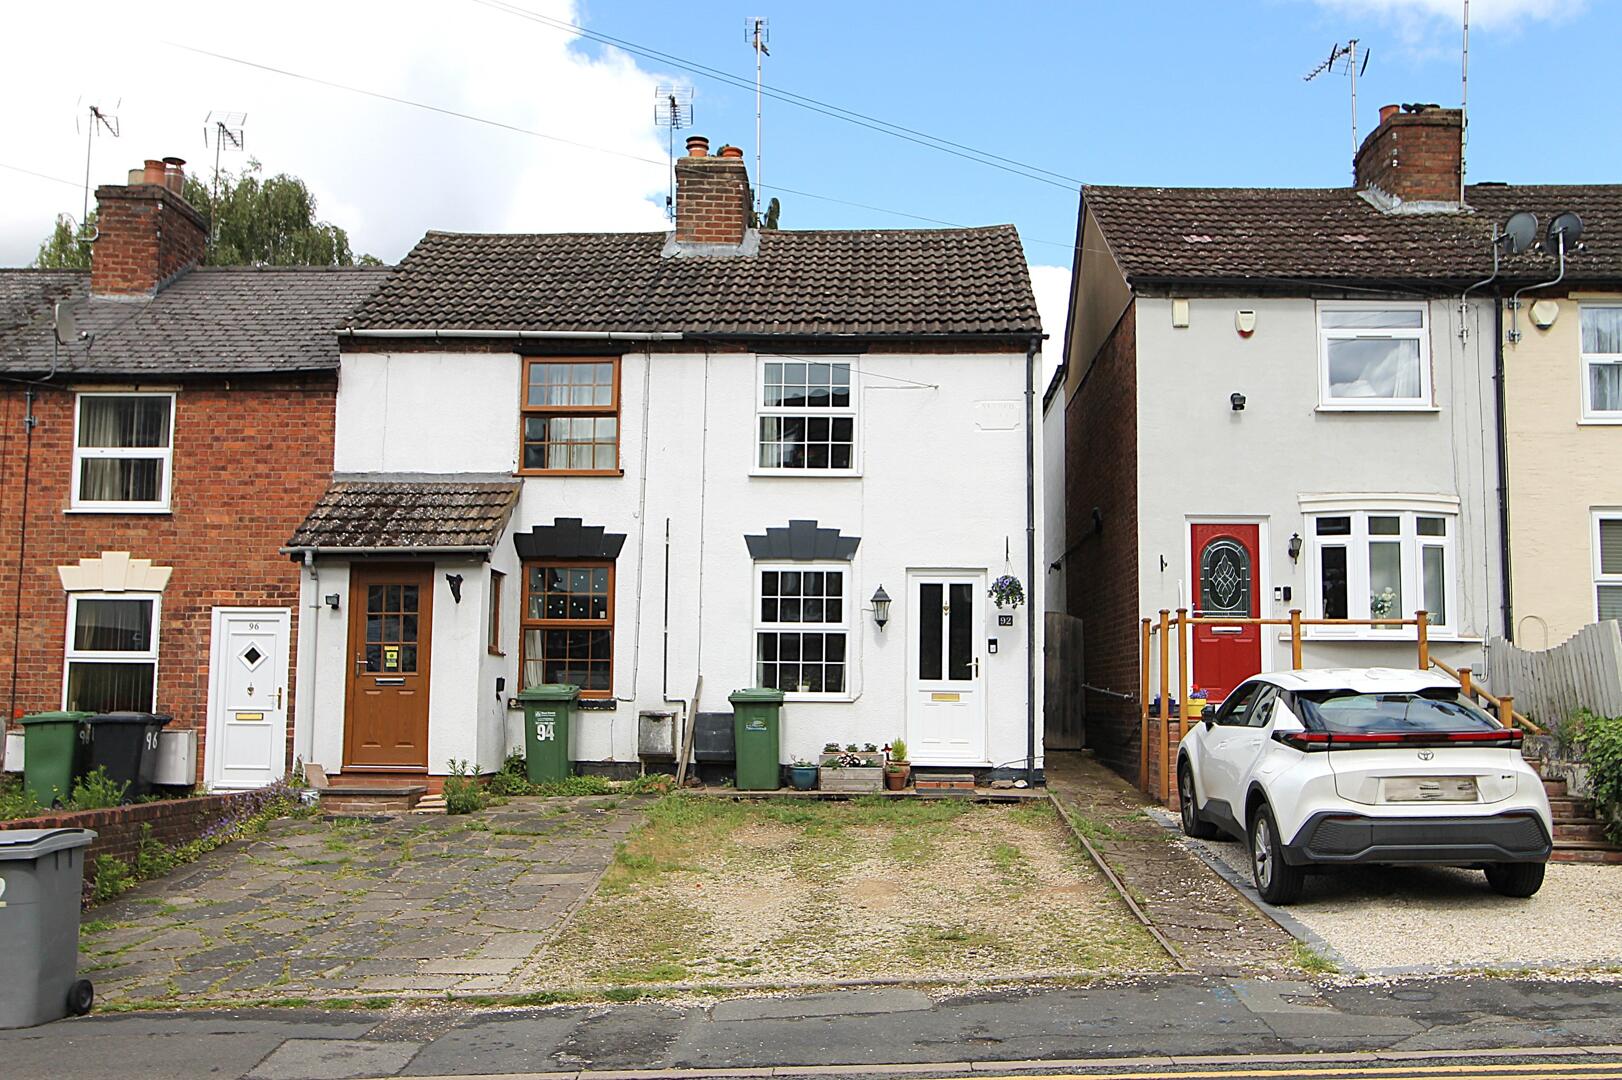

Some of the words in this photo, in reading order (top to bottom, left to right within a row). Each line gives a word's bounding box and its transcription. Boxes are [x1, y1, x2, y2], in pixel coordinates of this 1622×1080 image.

[248, 622, 260, 631] 96
[1000, 616, 1012, 625] 92
[536, 724, 555, 741] 94
[146, 731, 158, 751] 96
